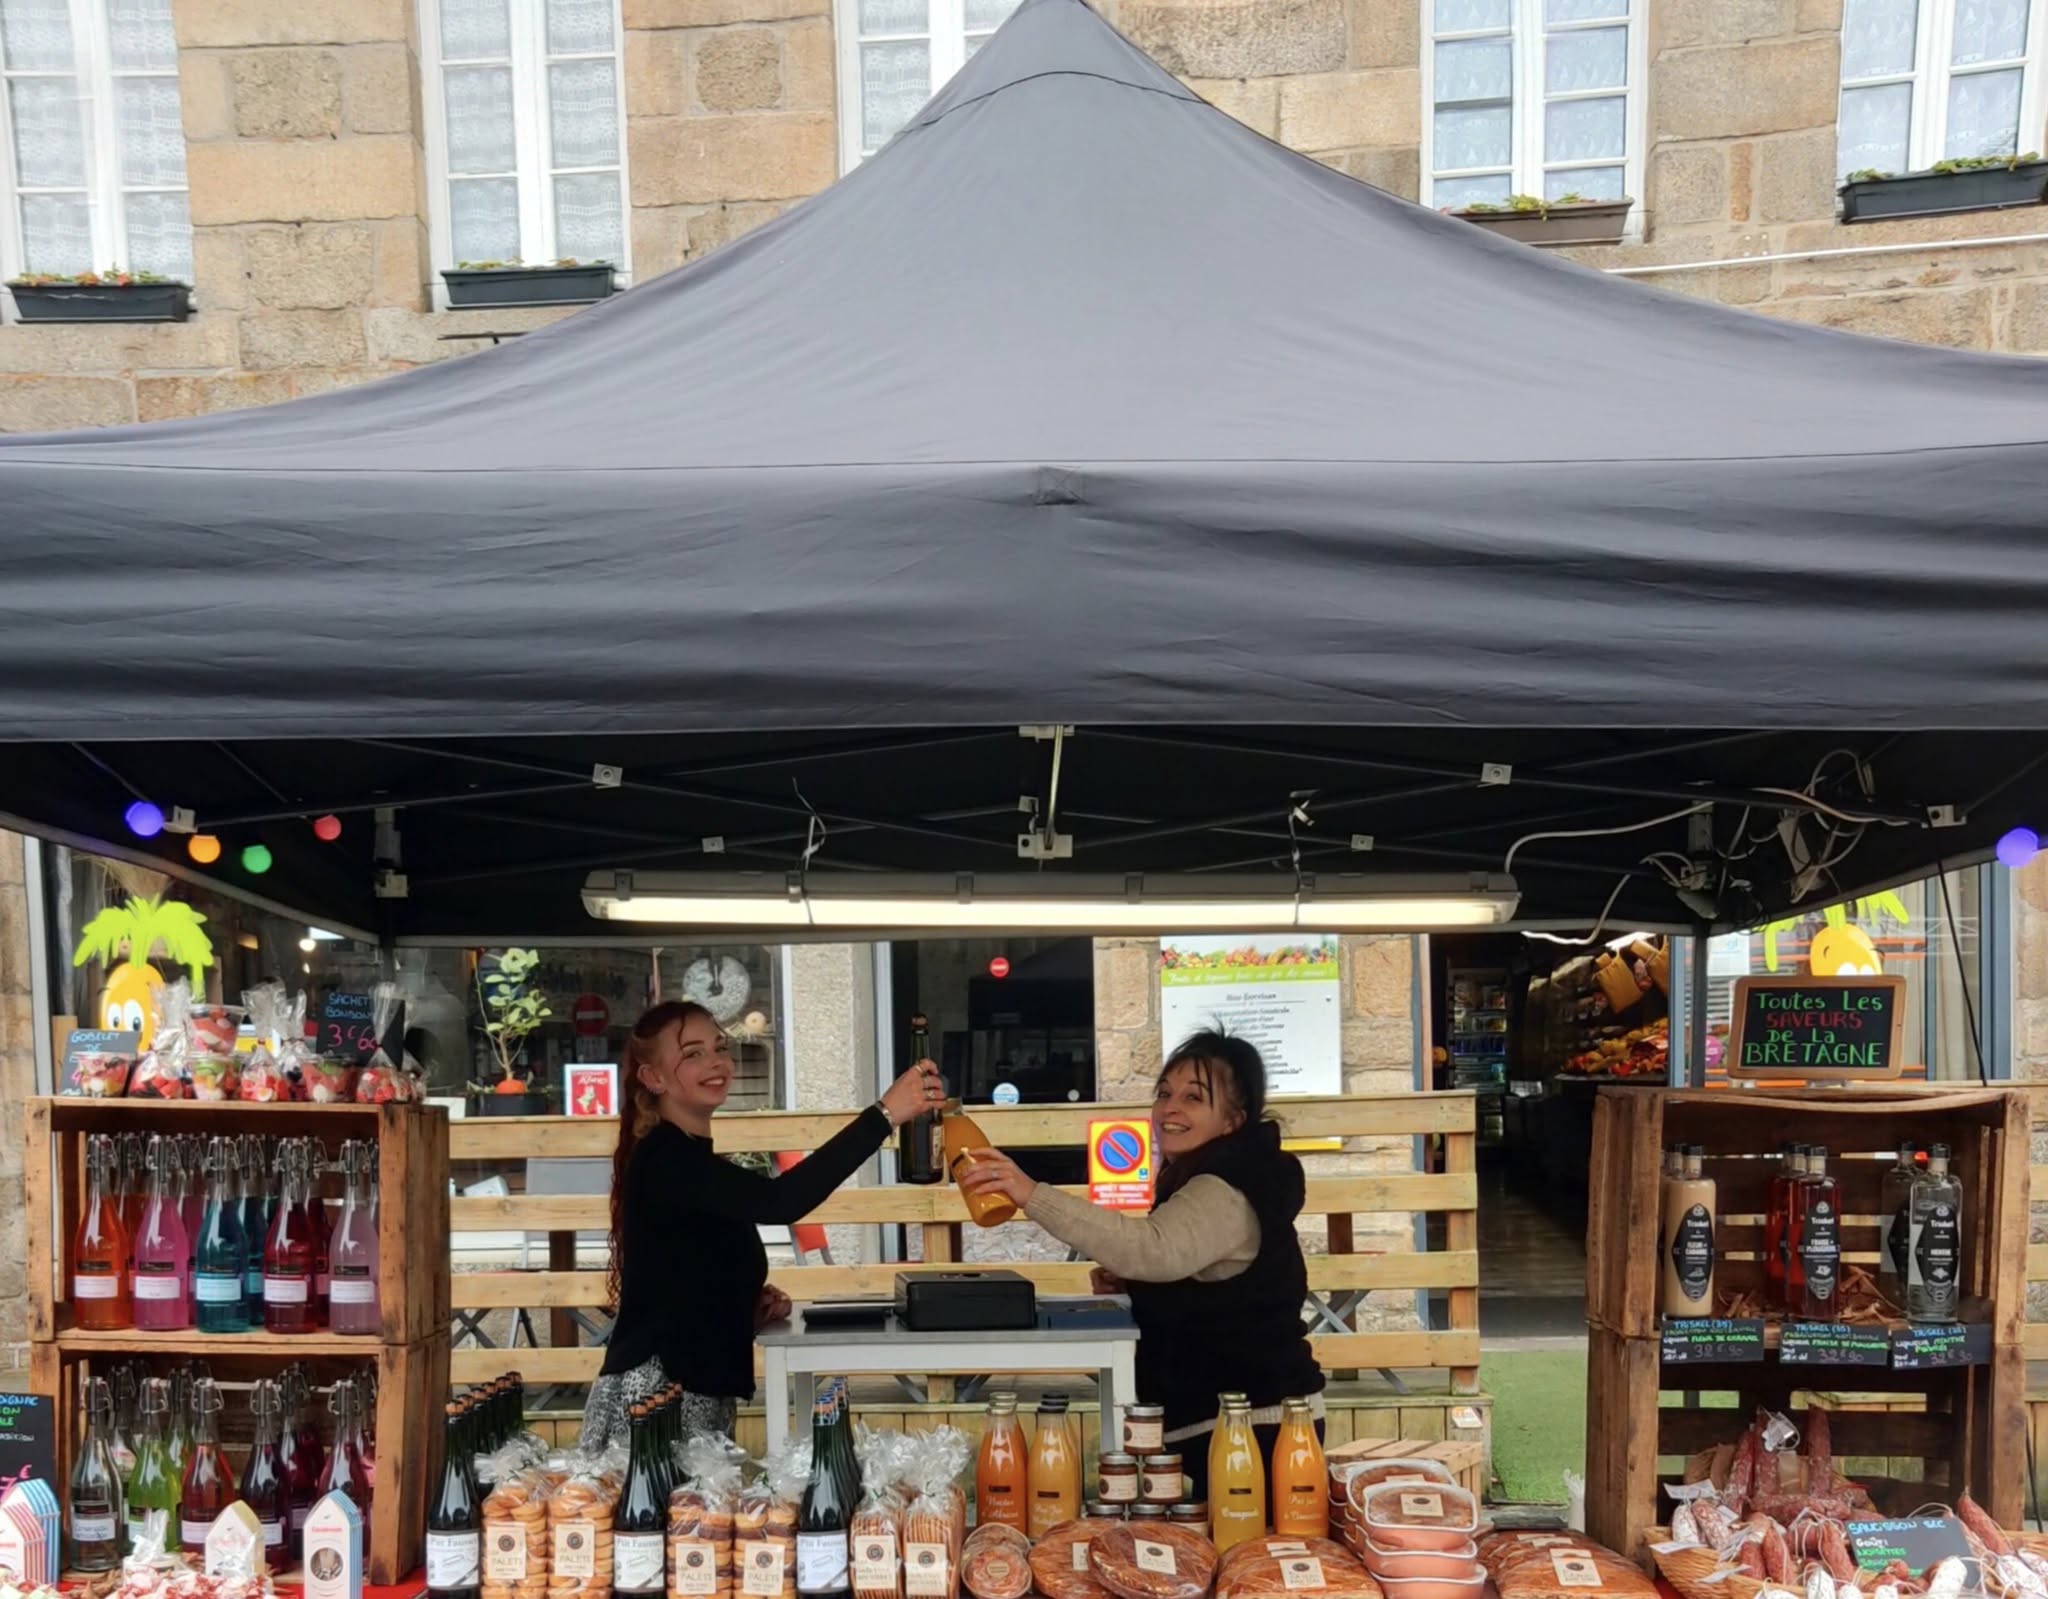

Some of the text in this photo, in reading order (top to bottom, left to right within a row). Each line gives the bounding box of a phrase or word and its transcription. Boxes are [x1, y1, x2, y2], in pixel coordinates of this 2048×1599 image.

[328, 991, 369, 1006] SACHET
[1755, 990, 1883, 1011] Toutes Les
[1766, 1011, 1863, 1029] SAVEURS
[71, 1031, 120, 1043] GOBELET
[1812, 1027, 1836, 1044] La
[1745, 1042, 1884, 1066] BRETAGNE
[1674, 1320, 1711, 1329] TRISKEL
[1847, 1520, 1946, 1535] SAUCISSON SEC
